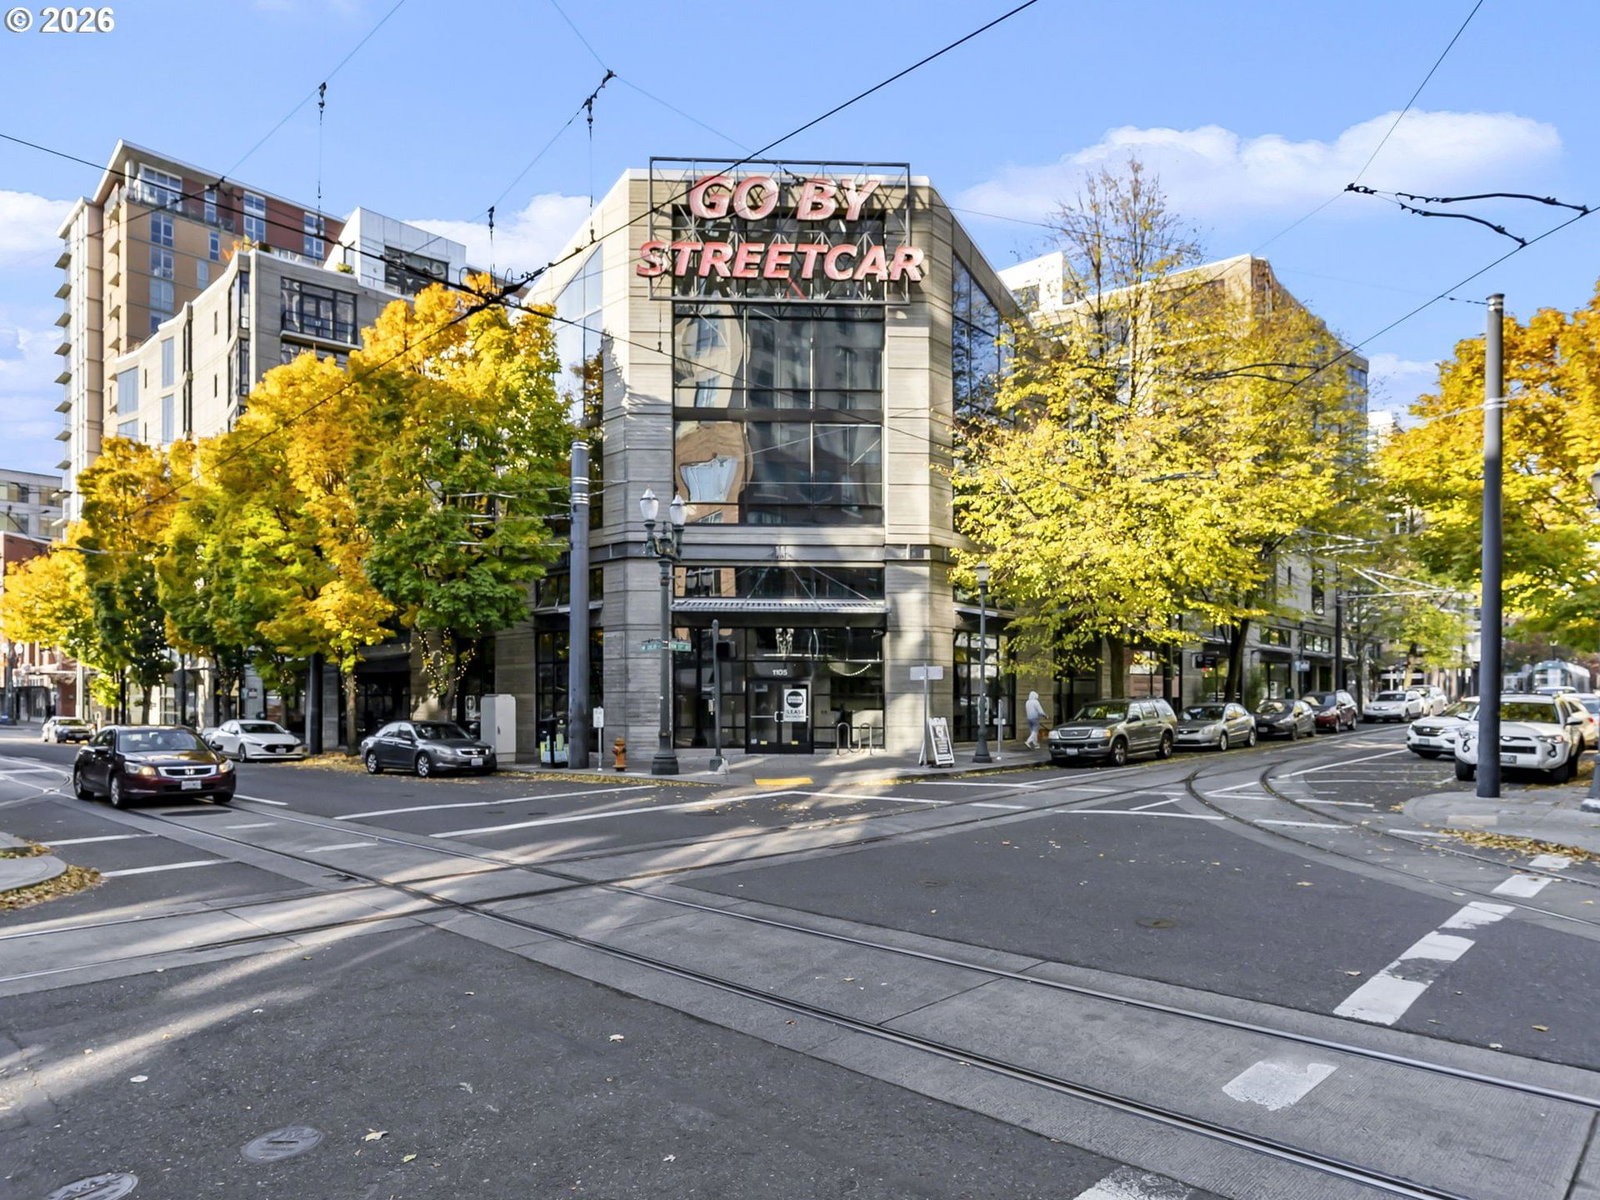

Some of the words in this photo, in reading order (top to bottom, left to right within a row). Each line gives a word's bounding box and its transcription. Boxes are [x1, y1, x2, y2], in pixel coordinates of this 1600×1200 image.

[689, 175, 779, 221] GO
[795, 177, 881, 221] BY
[636, 241, 925, 282] STREETCAR
